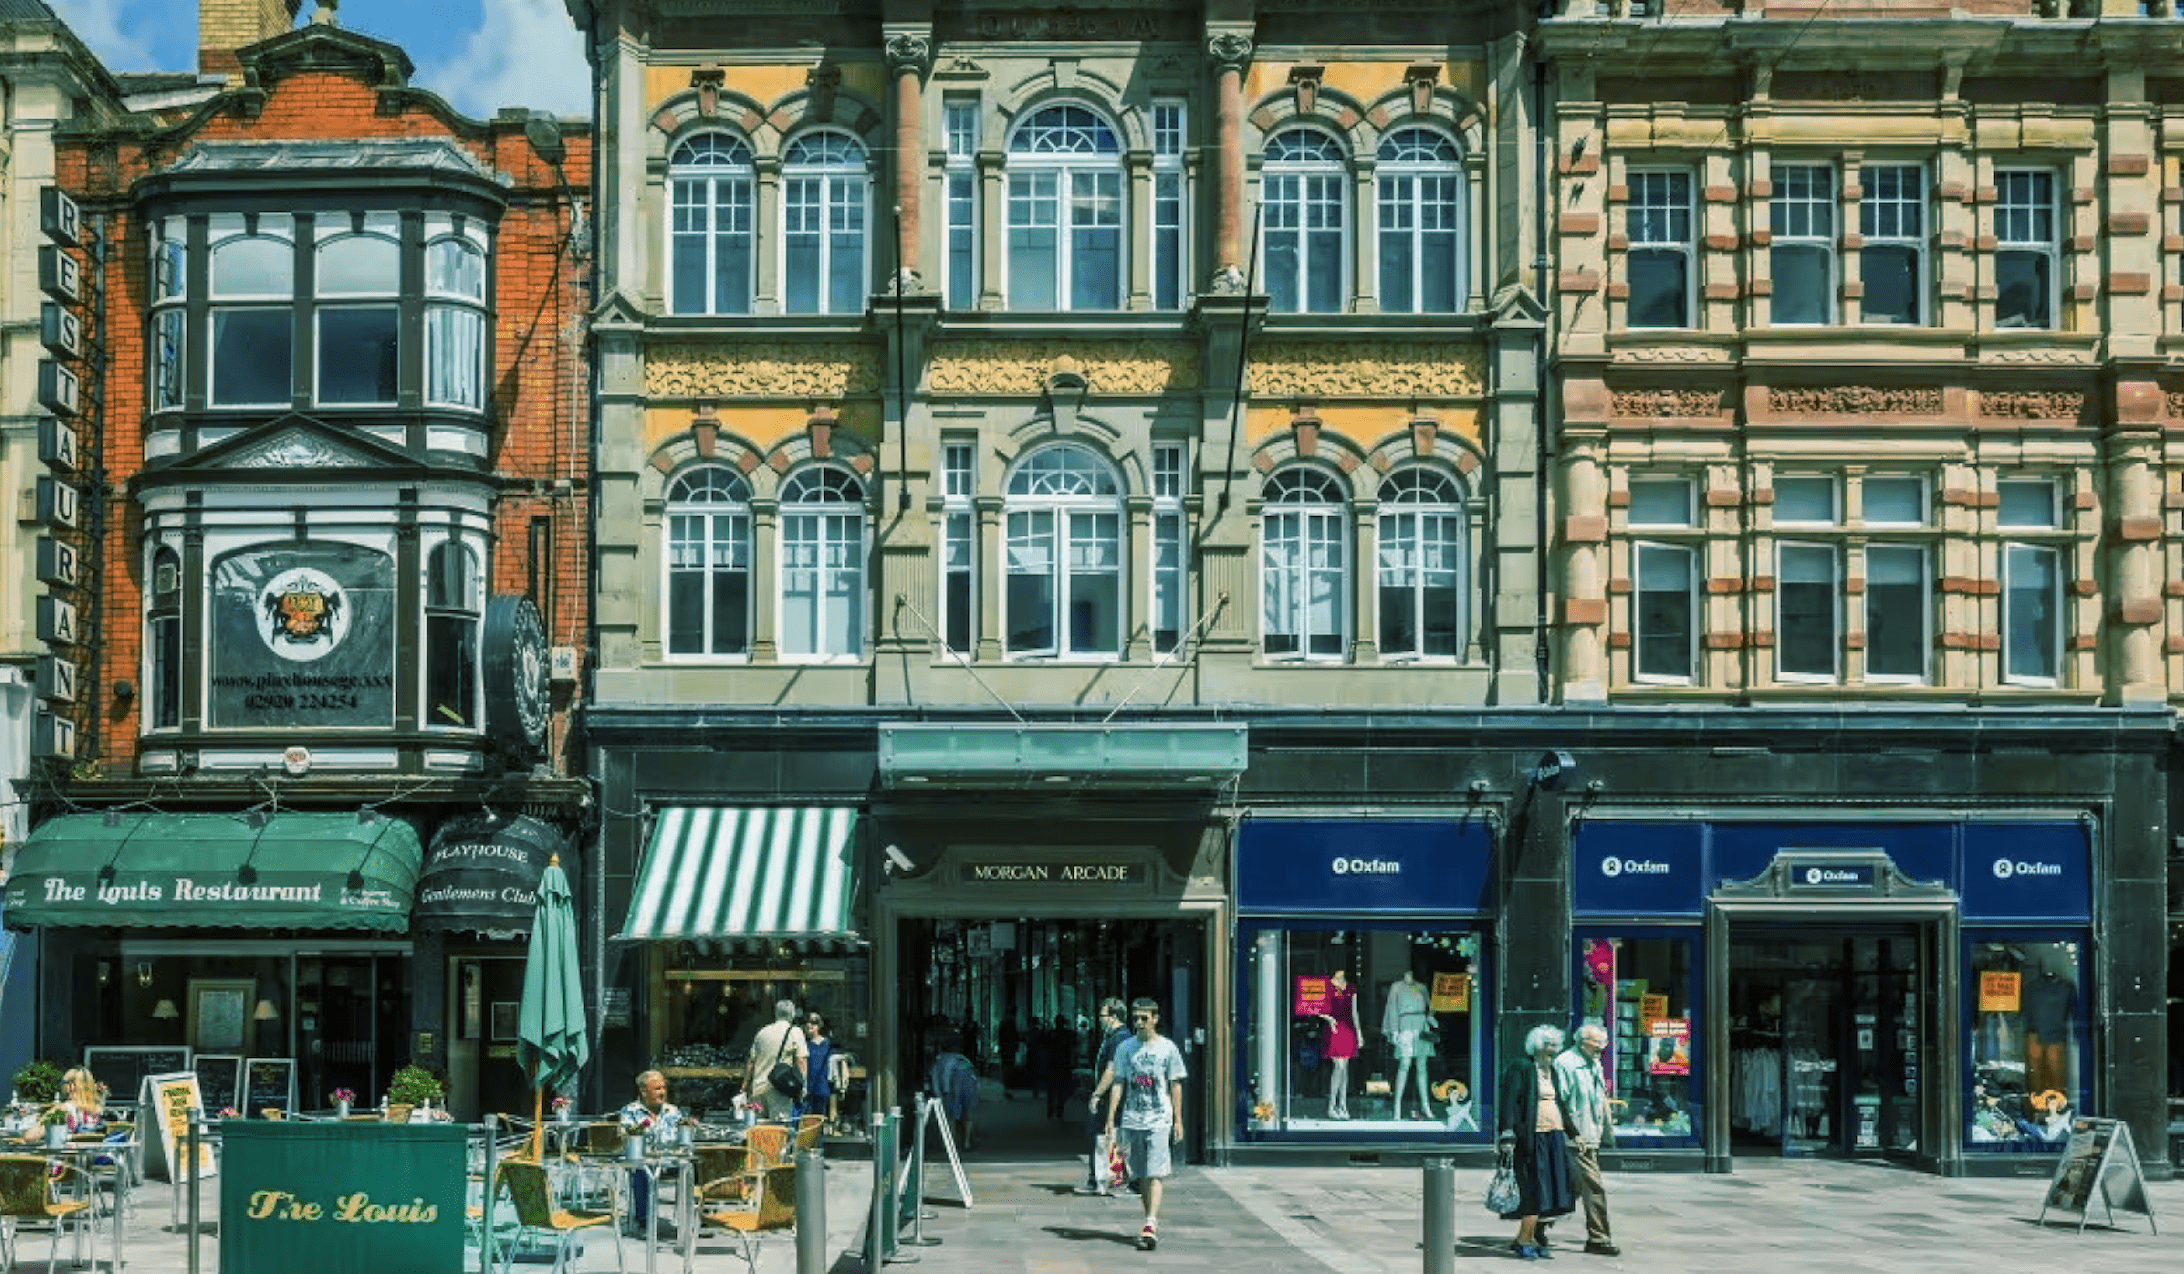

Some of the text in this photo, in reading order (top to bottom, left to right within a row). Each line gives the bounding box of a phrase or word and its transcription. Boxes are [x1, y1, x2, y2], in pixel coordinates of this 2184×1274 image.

[56, 197, 77, 755] RESTAURANT
[432, 844, 529, 864] PLAYHOUSE
[975, 865, 1128, 880] MORGAN ARCADE
[1350, 858, 1400, 875] Oxfam
[1624, 859, 1670, 874] Oxfam
[1824, 869, 1859, 881] Oxfam
[2016, 861, 2062, 875] Oxfam
[44, 878, 86, 901] The
[173, 878, 321, 902] Restaurant
[501, 886, 536, 905] Club
[247, 1190, 438, 1223] The Louis
